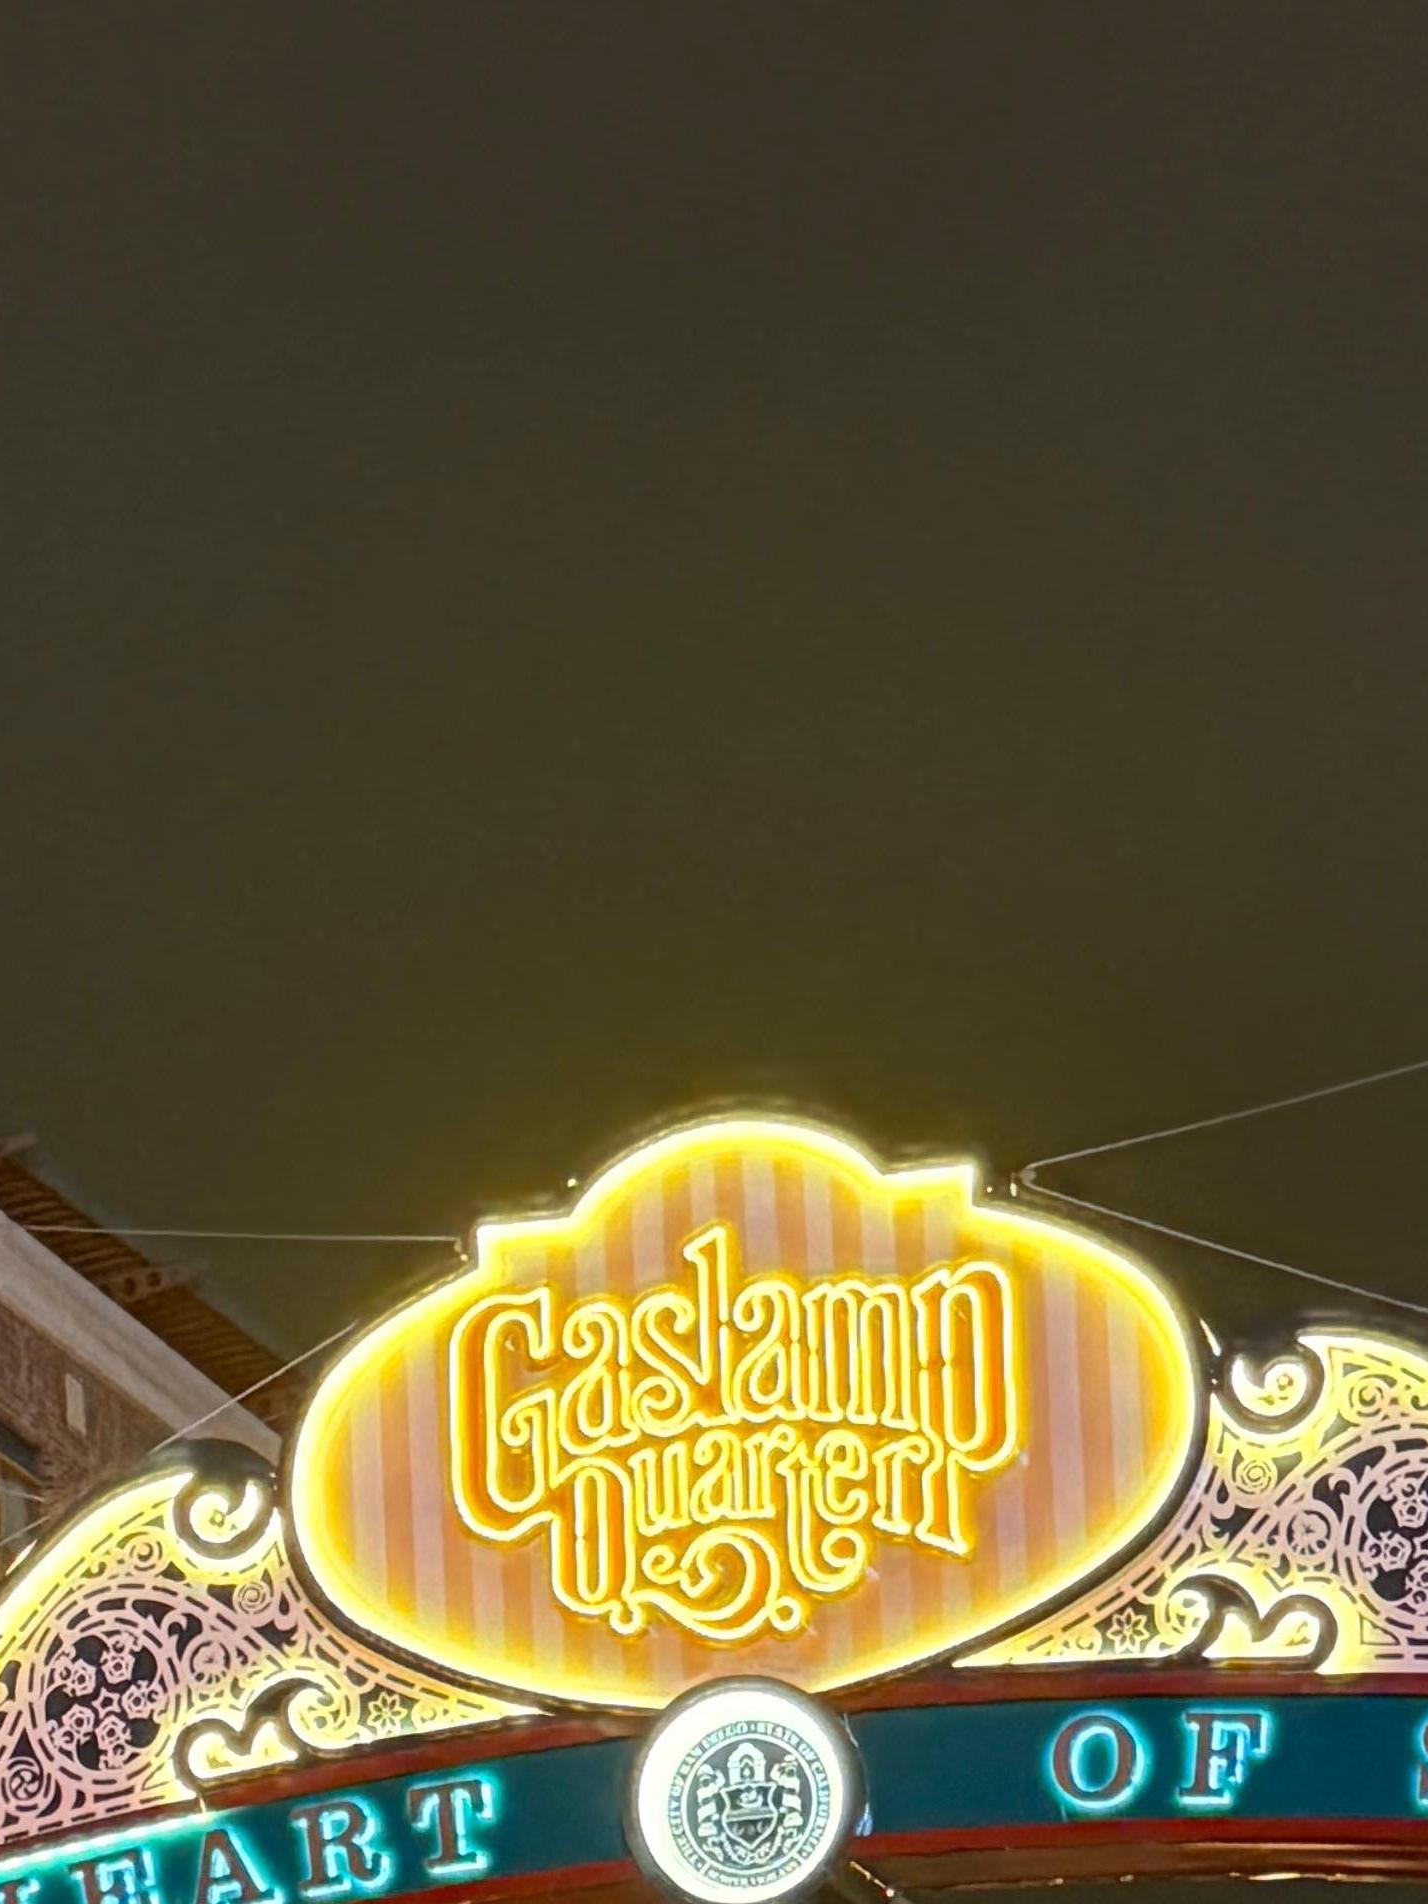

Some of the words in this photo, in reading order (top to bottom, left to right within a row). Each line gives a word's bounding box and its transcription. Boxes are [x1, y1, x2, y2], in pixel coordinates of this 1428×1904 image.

[448, 1221, 1018, 1541] Gaslamp
[548, 1424, 974, 1642] Quarter
[1047, 1709, 1272, 1812] OF
